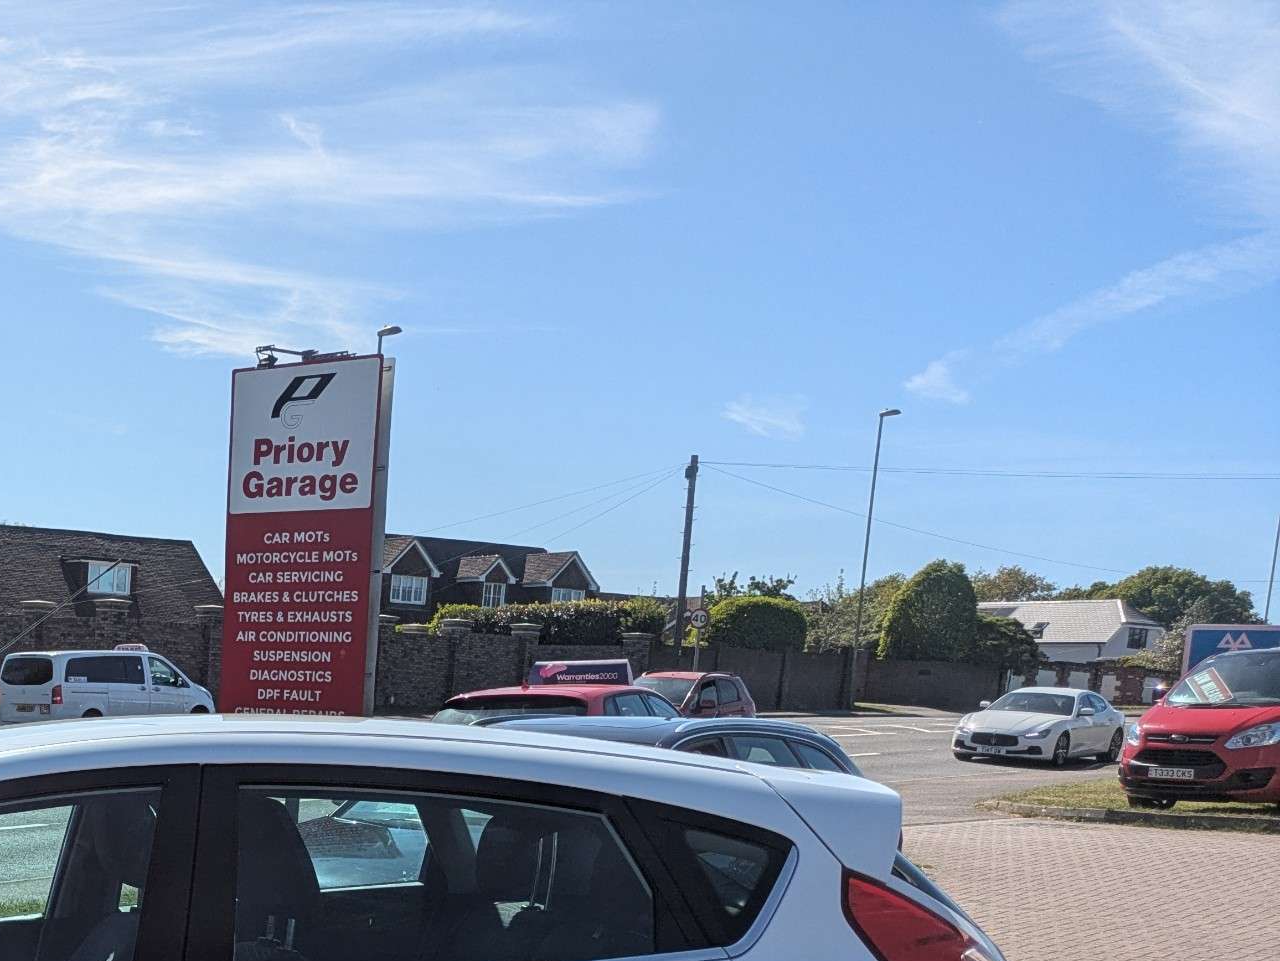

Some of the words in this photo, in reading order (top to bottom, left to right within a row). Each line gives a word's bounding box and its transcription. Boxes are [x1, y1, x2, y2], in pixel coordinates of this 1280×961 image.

[253, 435, 350, 467] Priory
[242, 470, 359, 501] Garage
[263, 533, 290, 544] CAR
[293, 531, 330, 543] MOTs
[236, 552, 320, 564] MOTORCYCLE
[322, 550, 358, 562] MOTs
[248, 572, 273, 583] CAR
[276, 570, 344, 583] SERVICING
[233, 591, 279, 603] BRAKES
[282, 591, 290, 603] &
[293, 590, 359, 602] CLUTCHES
[237, 611, 273, 623] TYRES
[276, 611, 284, 623] &
[287, 610, 353, 623] EXHAUSTS
[692, 614, 706, 624] 40
[236, 630, 256, 642] AIR
[259, 630, 352, 643] CONDITIONING
[253, 650, 331, 662] SUSPENSION
[249, 669, 332, 682] DIAGNOSTICS
[257, 688, 281, 700] DPF
[283, 689, 322, 702] FAULT
